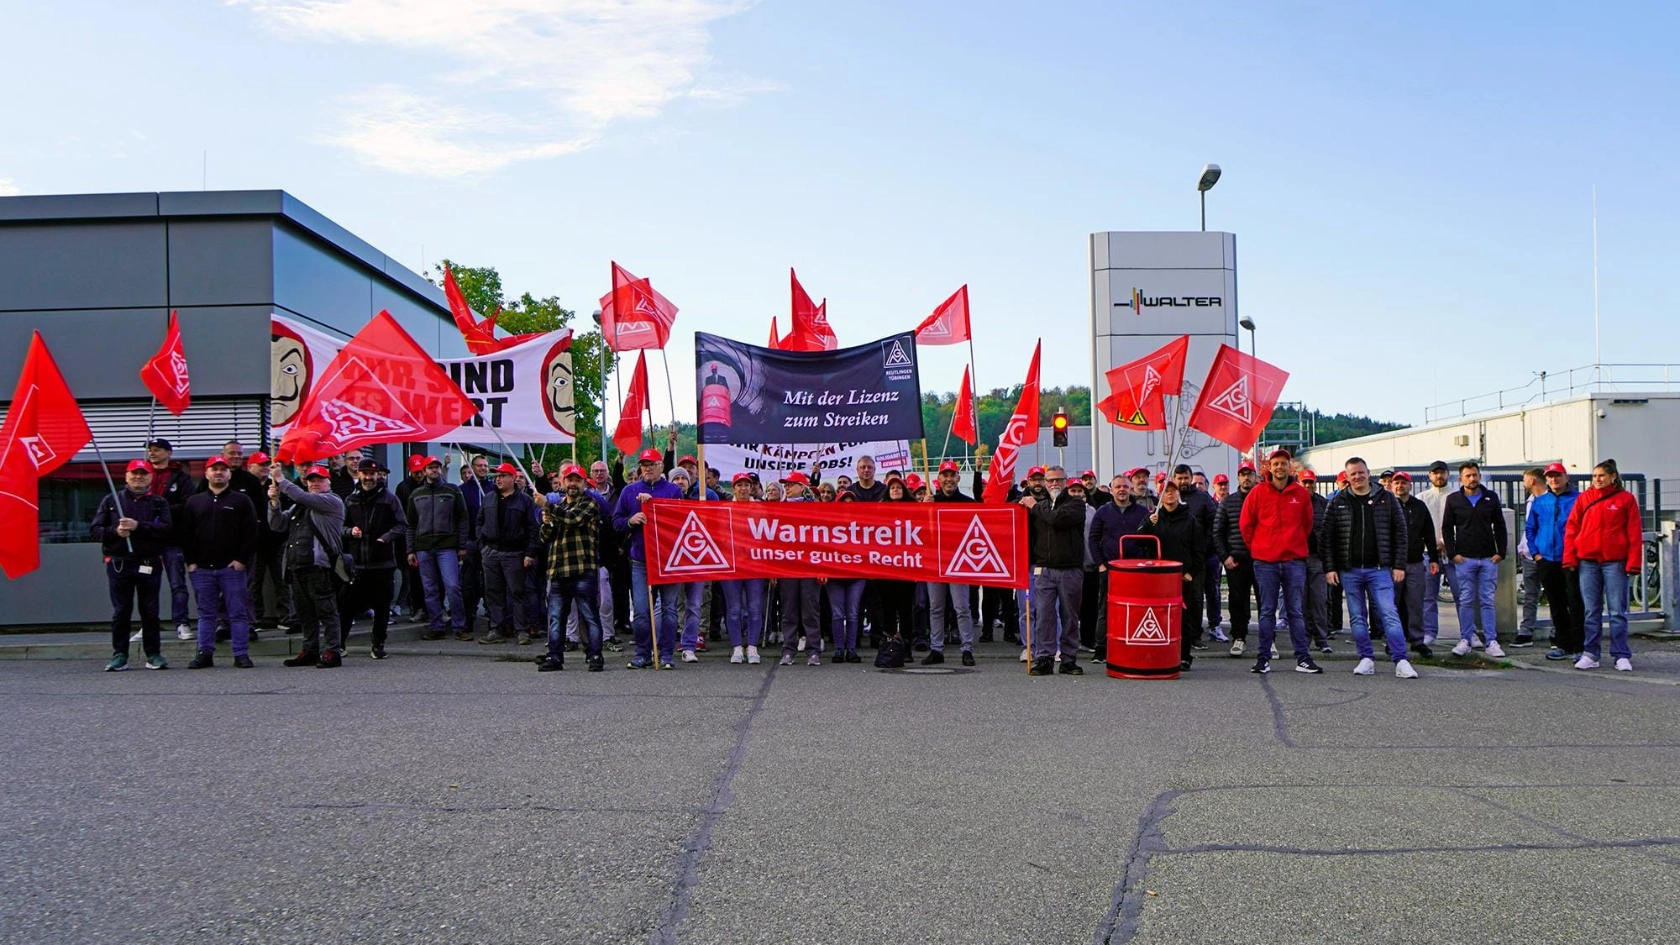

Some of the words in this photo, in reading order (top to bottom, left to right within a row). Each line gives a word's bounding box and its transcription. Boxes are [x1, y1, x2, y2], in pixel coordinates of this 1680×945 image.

[1143, 297, 1222, 307] WALTER
[336, 349, 416, 391] WIR
[424, 358, 515, 396] SIND
[783, 390, 814, 405] Mit
[818, 390, 844, 405] der
[847, 389, 899, 404] Lizenz
[399, 390, 509, 428] WERT
[783, 415, 819, 428] zum
[824, 411, 889, 427] Streiken
[812, 456, 853, 470] OBS!
[747, 517, 924, 546] Warnstreik
[750, 547, 804, 561] unser
[809, 551, 863, 564] gutes
[869, 551, 923, 568] Recht
